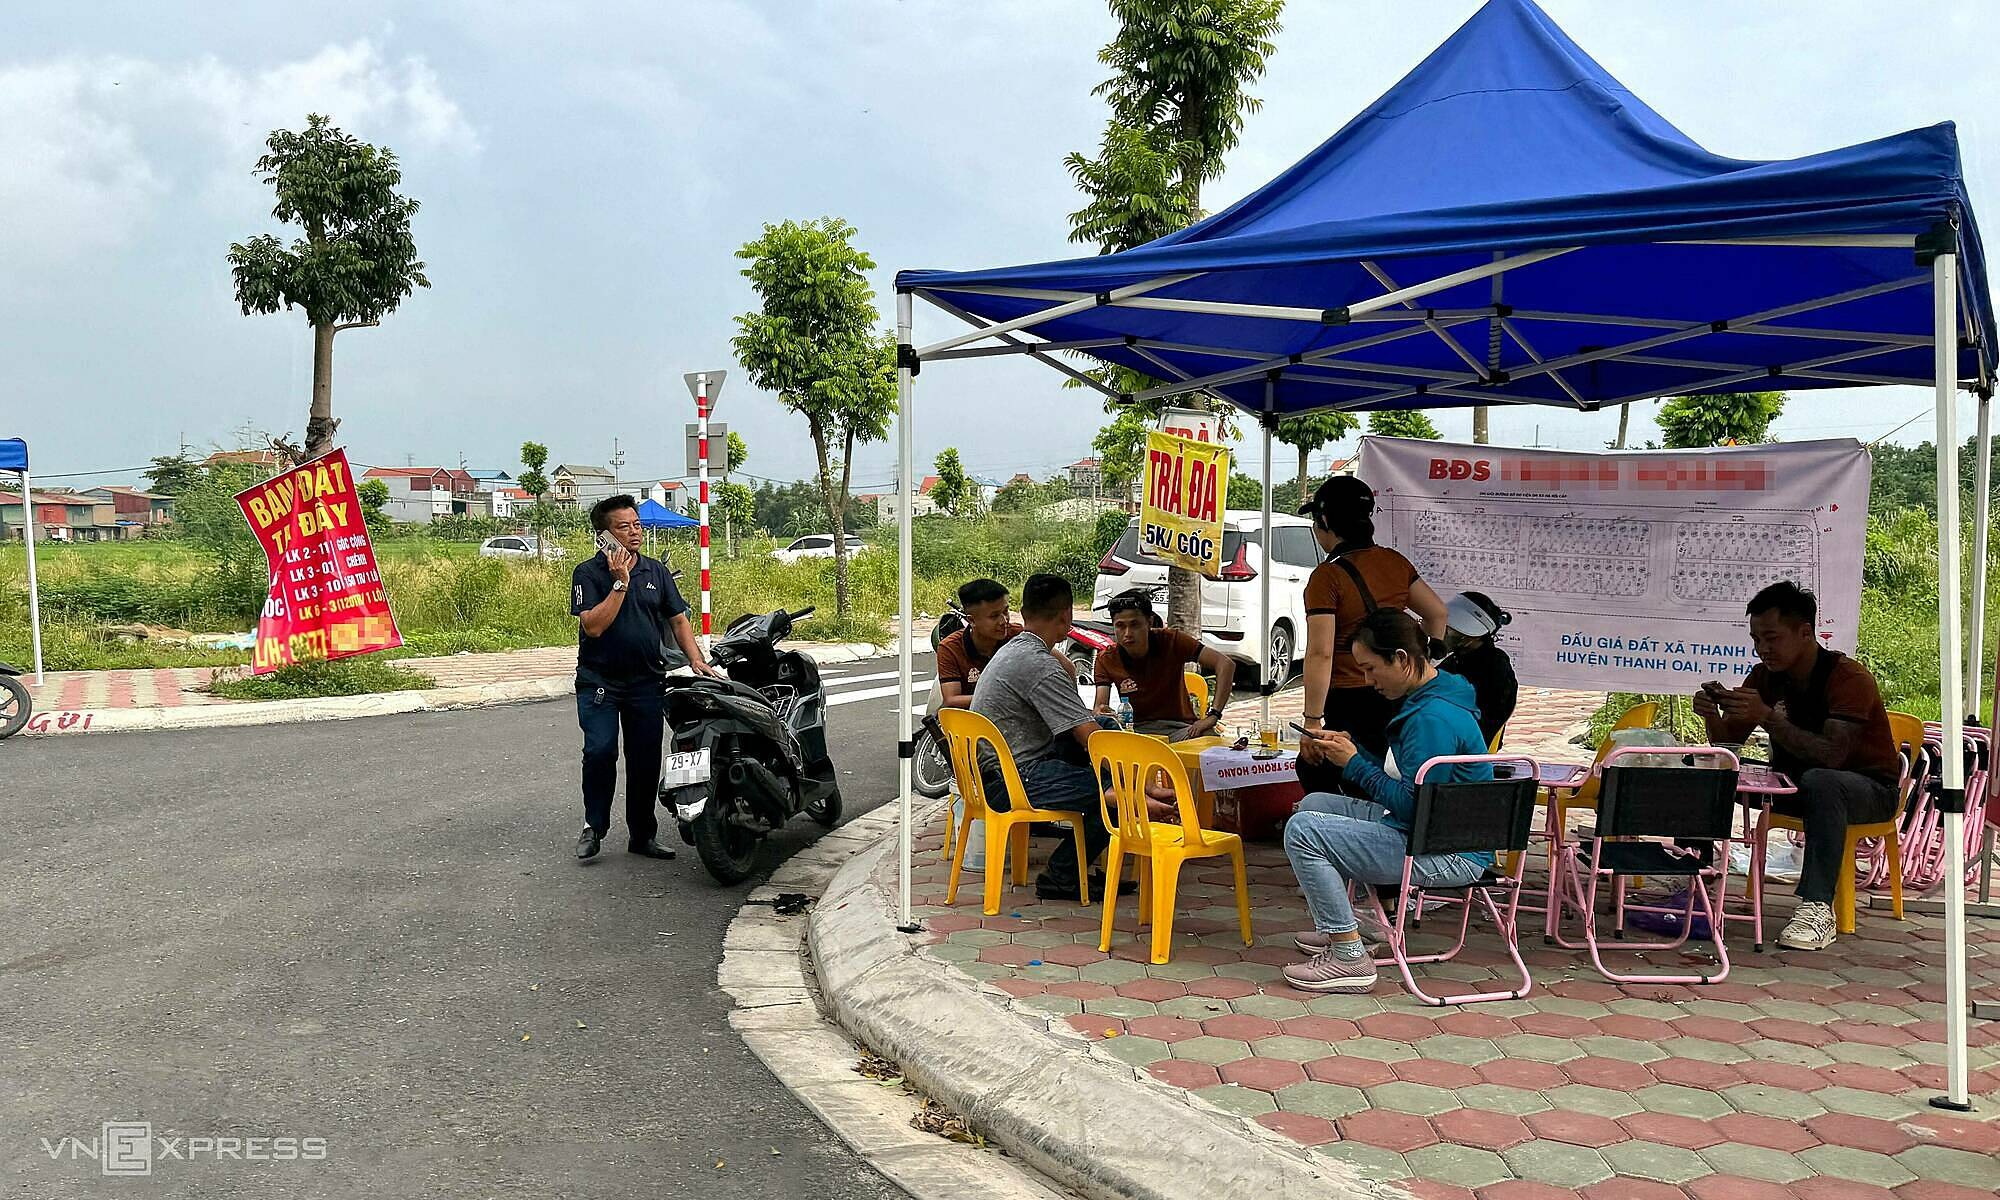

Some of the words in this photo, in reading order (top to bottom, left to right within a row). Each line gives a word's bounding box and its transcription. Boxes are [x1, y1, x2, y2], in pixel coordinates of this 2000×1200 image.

[1429, 458, 1491, 481] BĐS
[248, 478, 294, 529] BÁN
[296, 458, 347, 502] ĐẤT
[1149, 442, 1184, 515] TRÀ
[1187, 450, 1219, 523] ĐÁ
[298, 501, 348, 537] ĐÂY
[285, 548, 301, 563] LK
[303, 547, 311, 560] 2
[318, 541, 330, 555] 11
[1177, 529, 1213, 562] CỐC
[289, 567, 305, 583] LK
[306, 566, 314, 579] 3
[322, 560, 335, 575] 01
[294, 587, 310, 602] LK
[311, 585, 318, 597] 3
[326, 579, 341, 593] 10
[298, 605, 313, 620] LK
[1561, 632, 1592, 648] ĐẤU
[1597, 634, 1623, 650] GIÁ
[1628, 636, 1659, 653] ĐẤT
[1664, 640, 1685, 654] XÃ
[1690, 643, 1746, 658] THANH
[1556, 651, 1608, 668] HUYỆN
[1613, 655, 1666, 670] THANH
[1708, 662, 1728, 674] TP
[1251, 762, 1282, 774] TRỌNG
